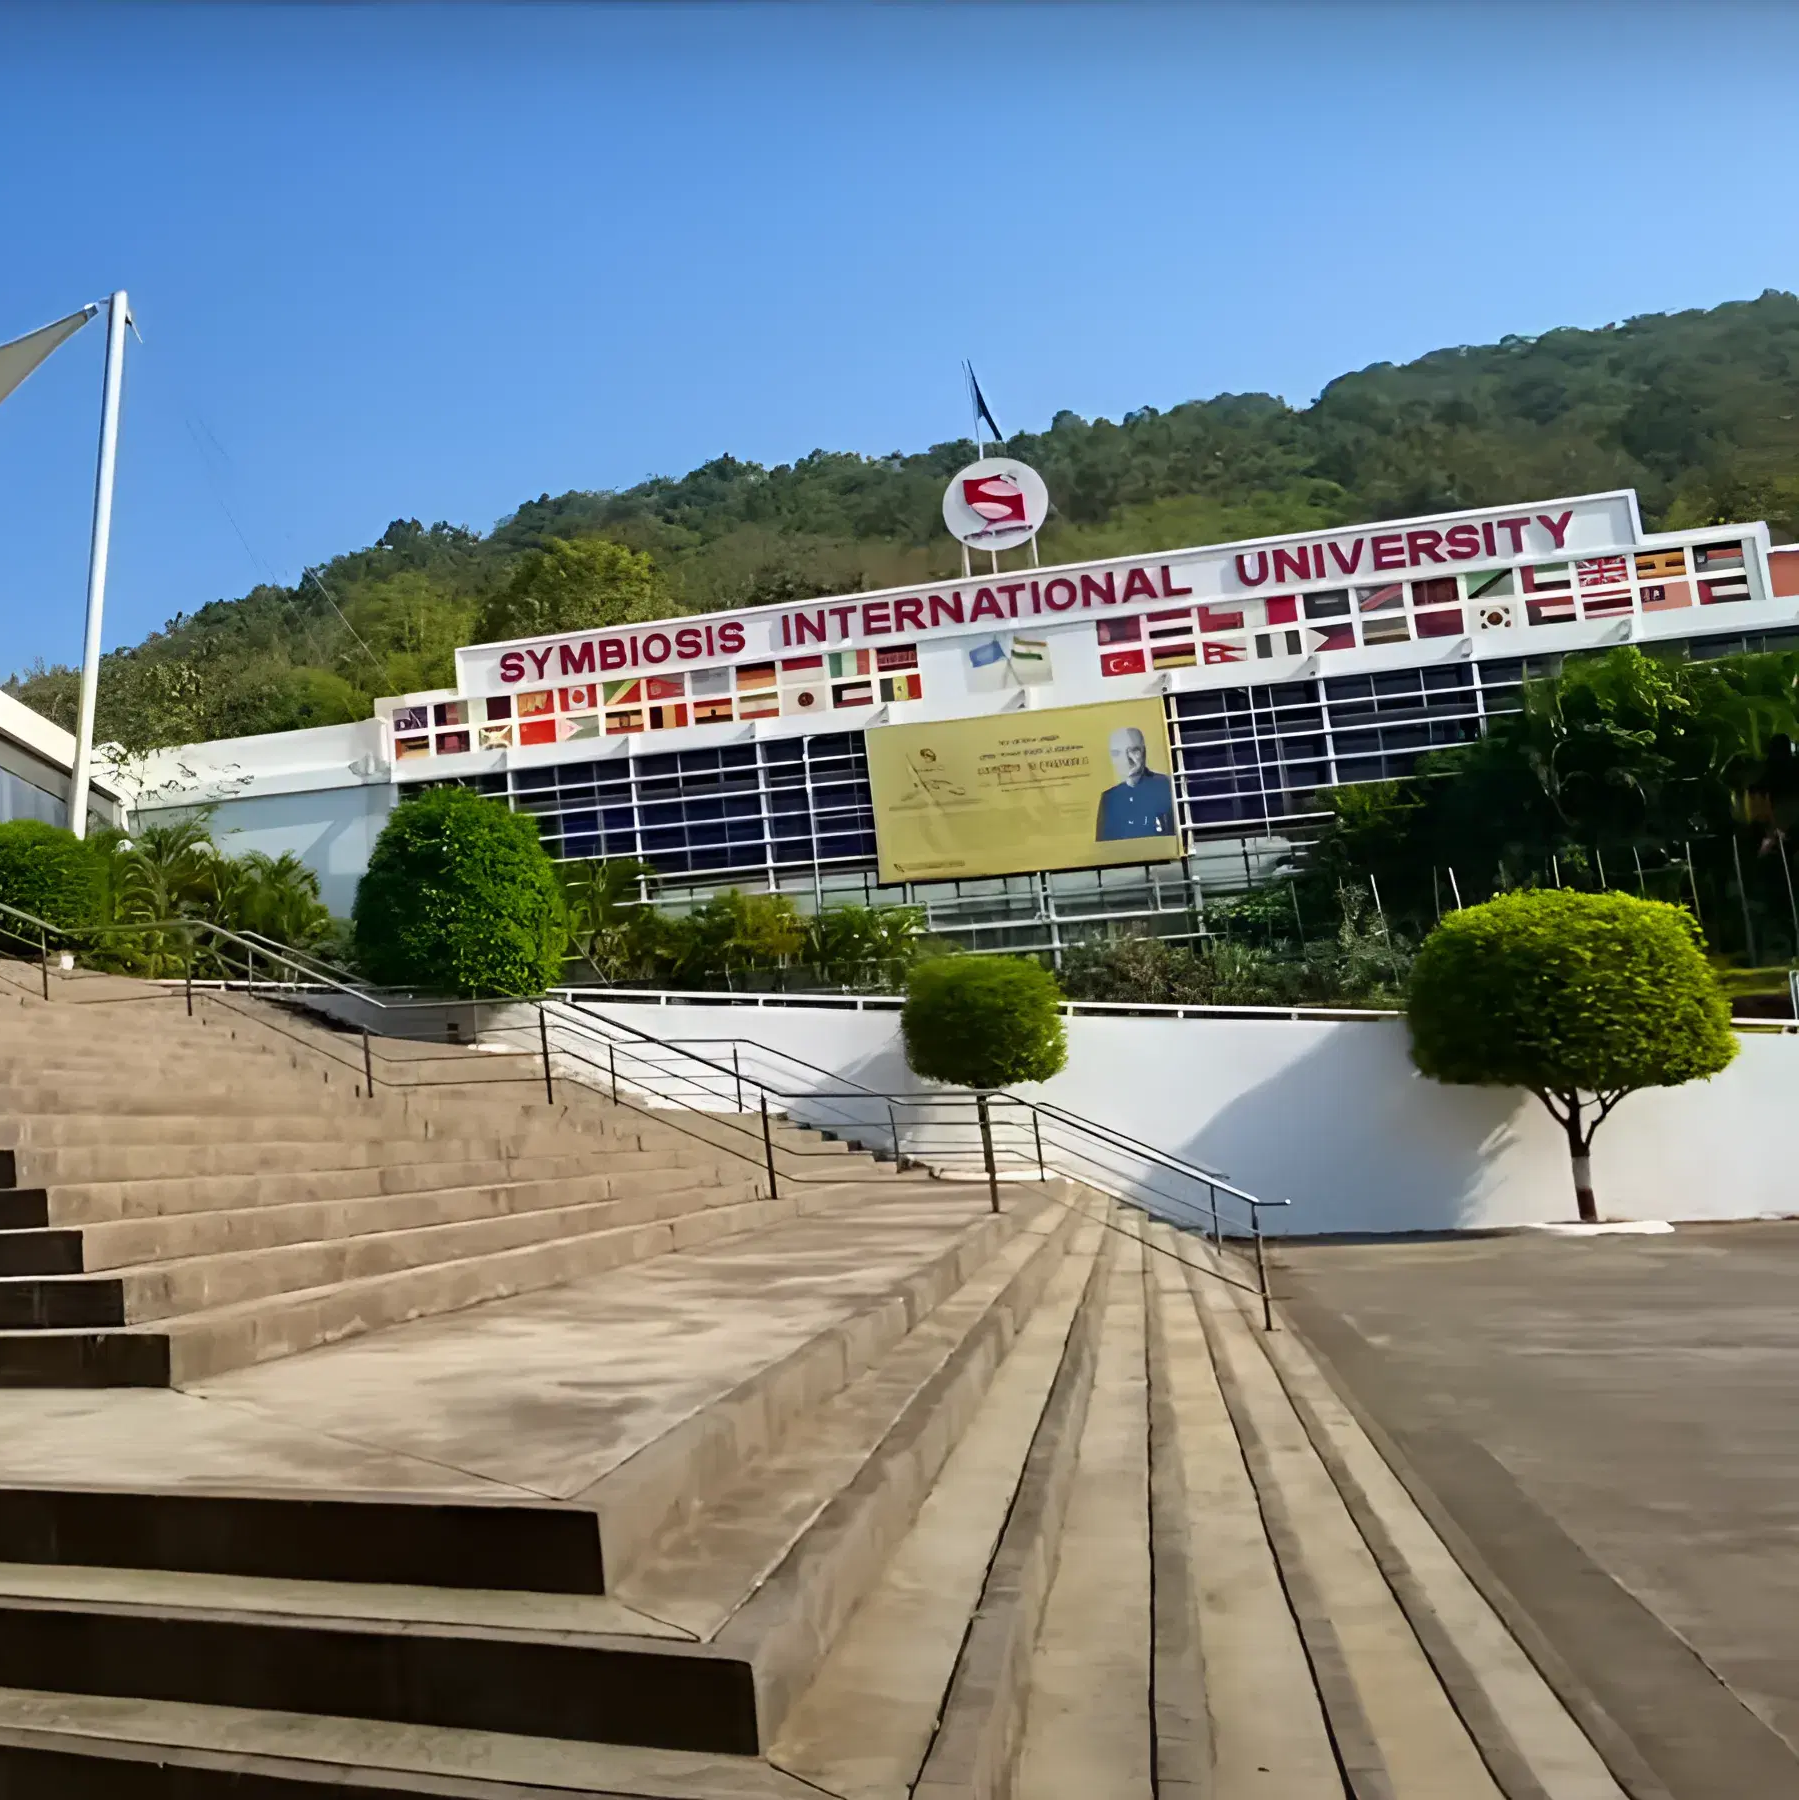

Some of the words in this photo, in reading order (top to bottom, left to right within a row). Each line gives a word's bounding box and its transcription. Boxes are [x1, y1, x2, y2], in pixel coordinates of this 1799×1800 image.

[500, 621, 746, 683] SYMBIOSIS
[781, 565, 1193, 647] INTERNATIONAL
[1235, 510, 1573, 587] UNIVERSITY
